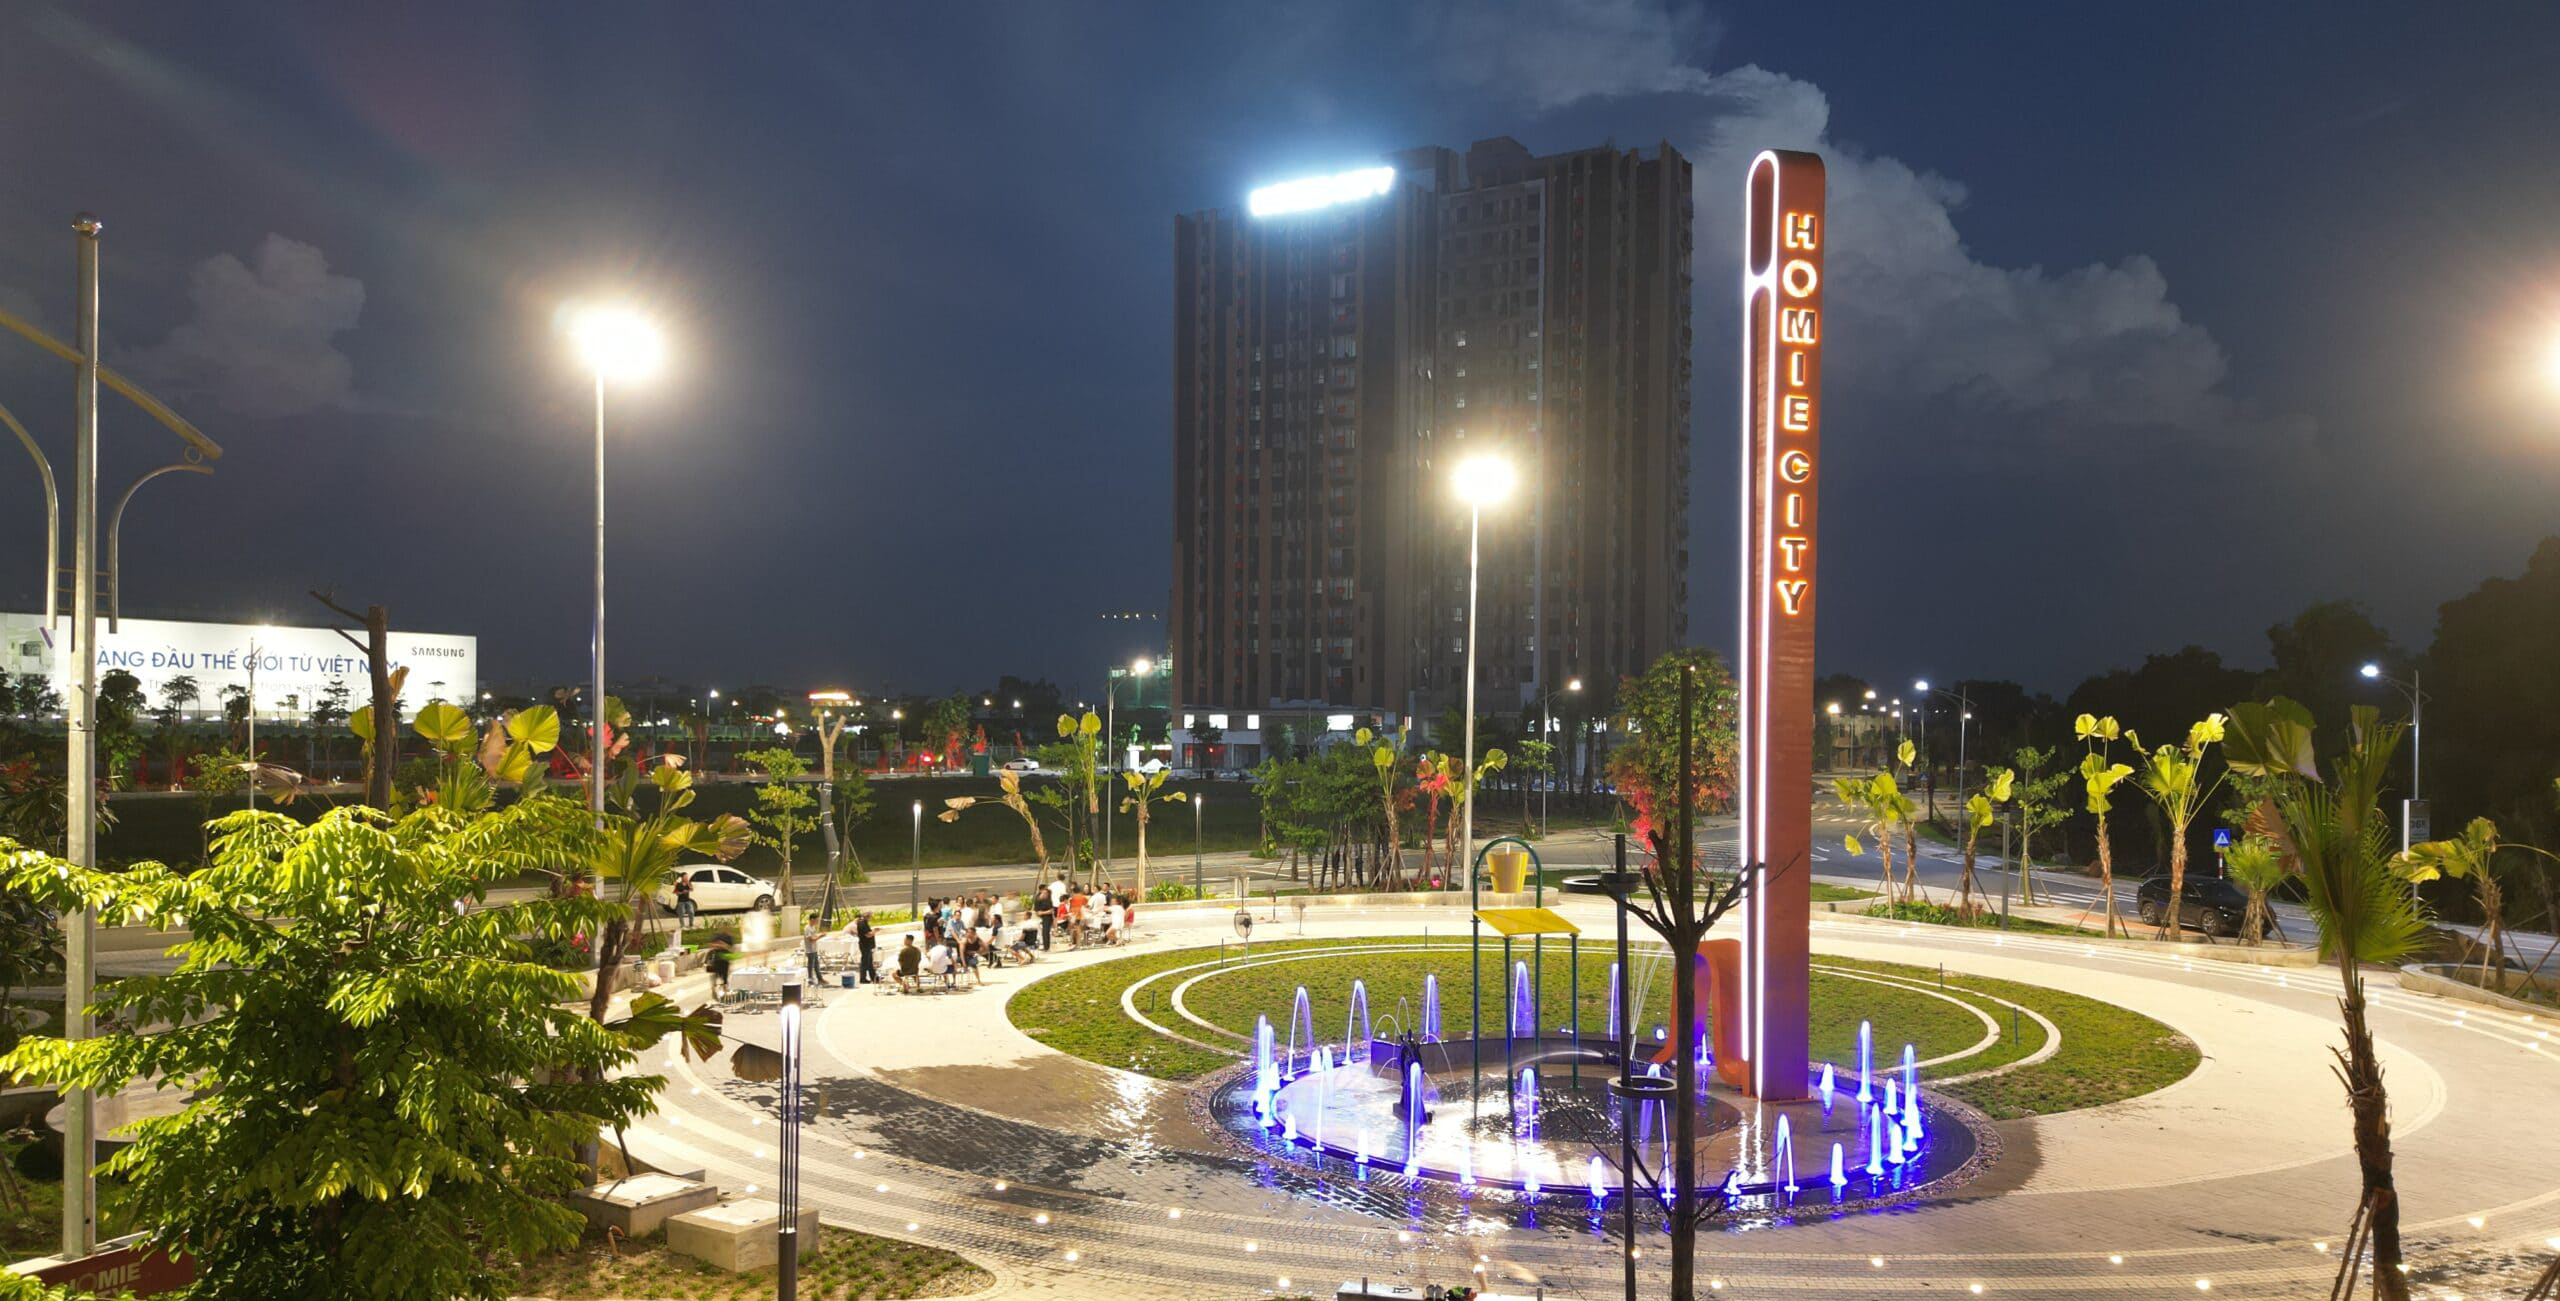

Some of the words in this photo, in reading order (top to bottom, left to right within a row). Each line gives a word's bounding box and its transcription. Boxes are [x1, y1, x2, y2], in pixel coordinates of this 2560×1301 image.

[1781, 211, 1818, 432] HOMIE
[1777, 450, 1810, 615] CITY
[97, 645, 145, 667] ÀNG
[151, 645, 195, 668] ĐẦU
[201, 647, 239, 670] THẾ
[288, 652, 313, 672] TỪ
[317, 653, 354, 677] VIỆT
[359, 659, 398, 674] NM
[411, 646, 465, 658] SAMSUNG
